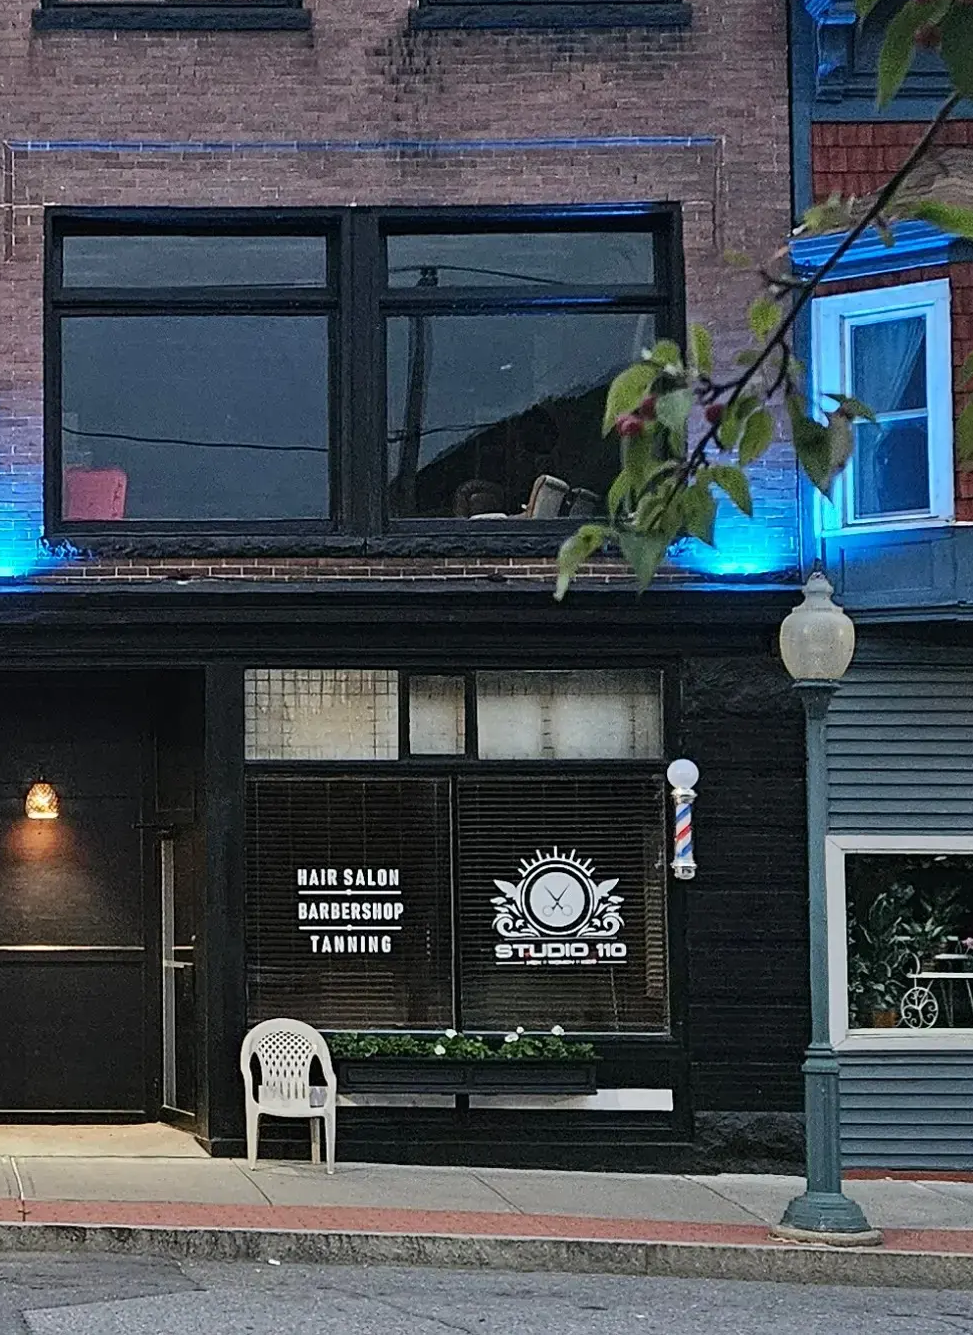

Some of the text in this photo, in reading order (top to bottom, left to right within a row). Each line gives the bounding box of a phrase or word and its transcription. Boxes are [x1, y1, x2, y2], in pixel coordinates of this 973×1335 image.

[297, 868, 399, 887] HAIR SALON
[298, 902, 404, 920] BARBERSHOP
[310, 935, 392, 953] TANNING
[494, 942, 628, 959] STUDIO 110
